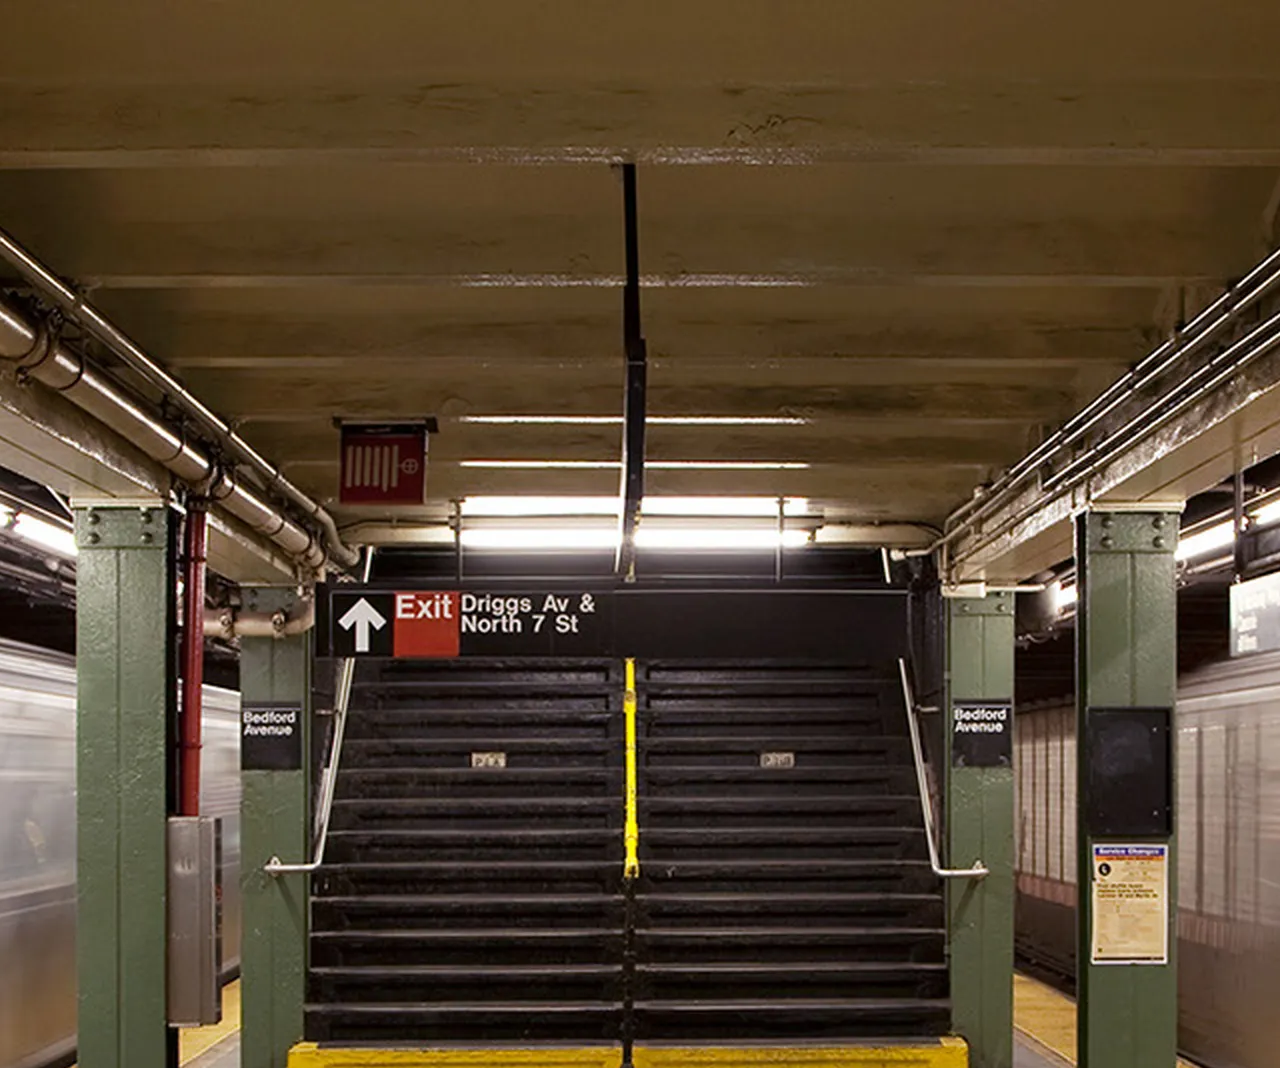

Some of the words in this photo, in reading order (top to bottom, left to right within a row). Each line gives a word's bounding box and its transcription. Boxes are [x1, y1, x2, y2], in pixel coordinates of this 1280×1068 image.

[395, 594, 452, 619] Exit
[461, 594, 532, 616] Driggs
[542, 594, 569, 613] Av
[579, 593, 596, 613] &
[461, 614, 522, 633] North
[532, 615, 545, 633] 7
[555, 614, 579, 633] St
[243, 711, 296, 724] Bedford
[954, 708, 1007, 721] Bedford
[243, 724, 293, 736] Avenue
[955, 721, 1004, 733] Avenue
